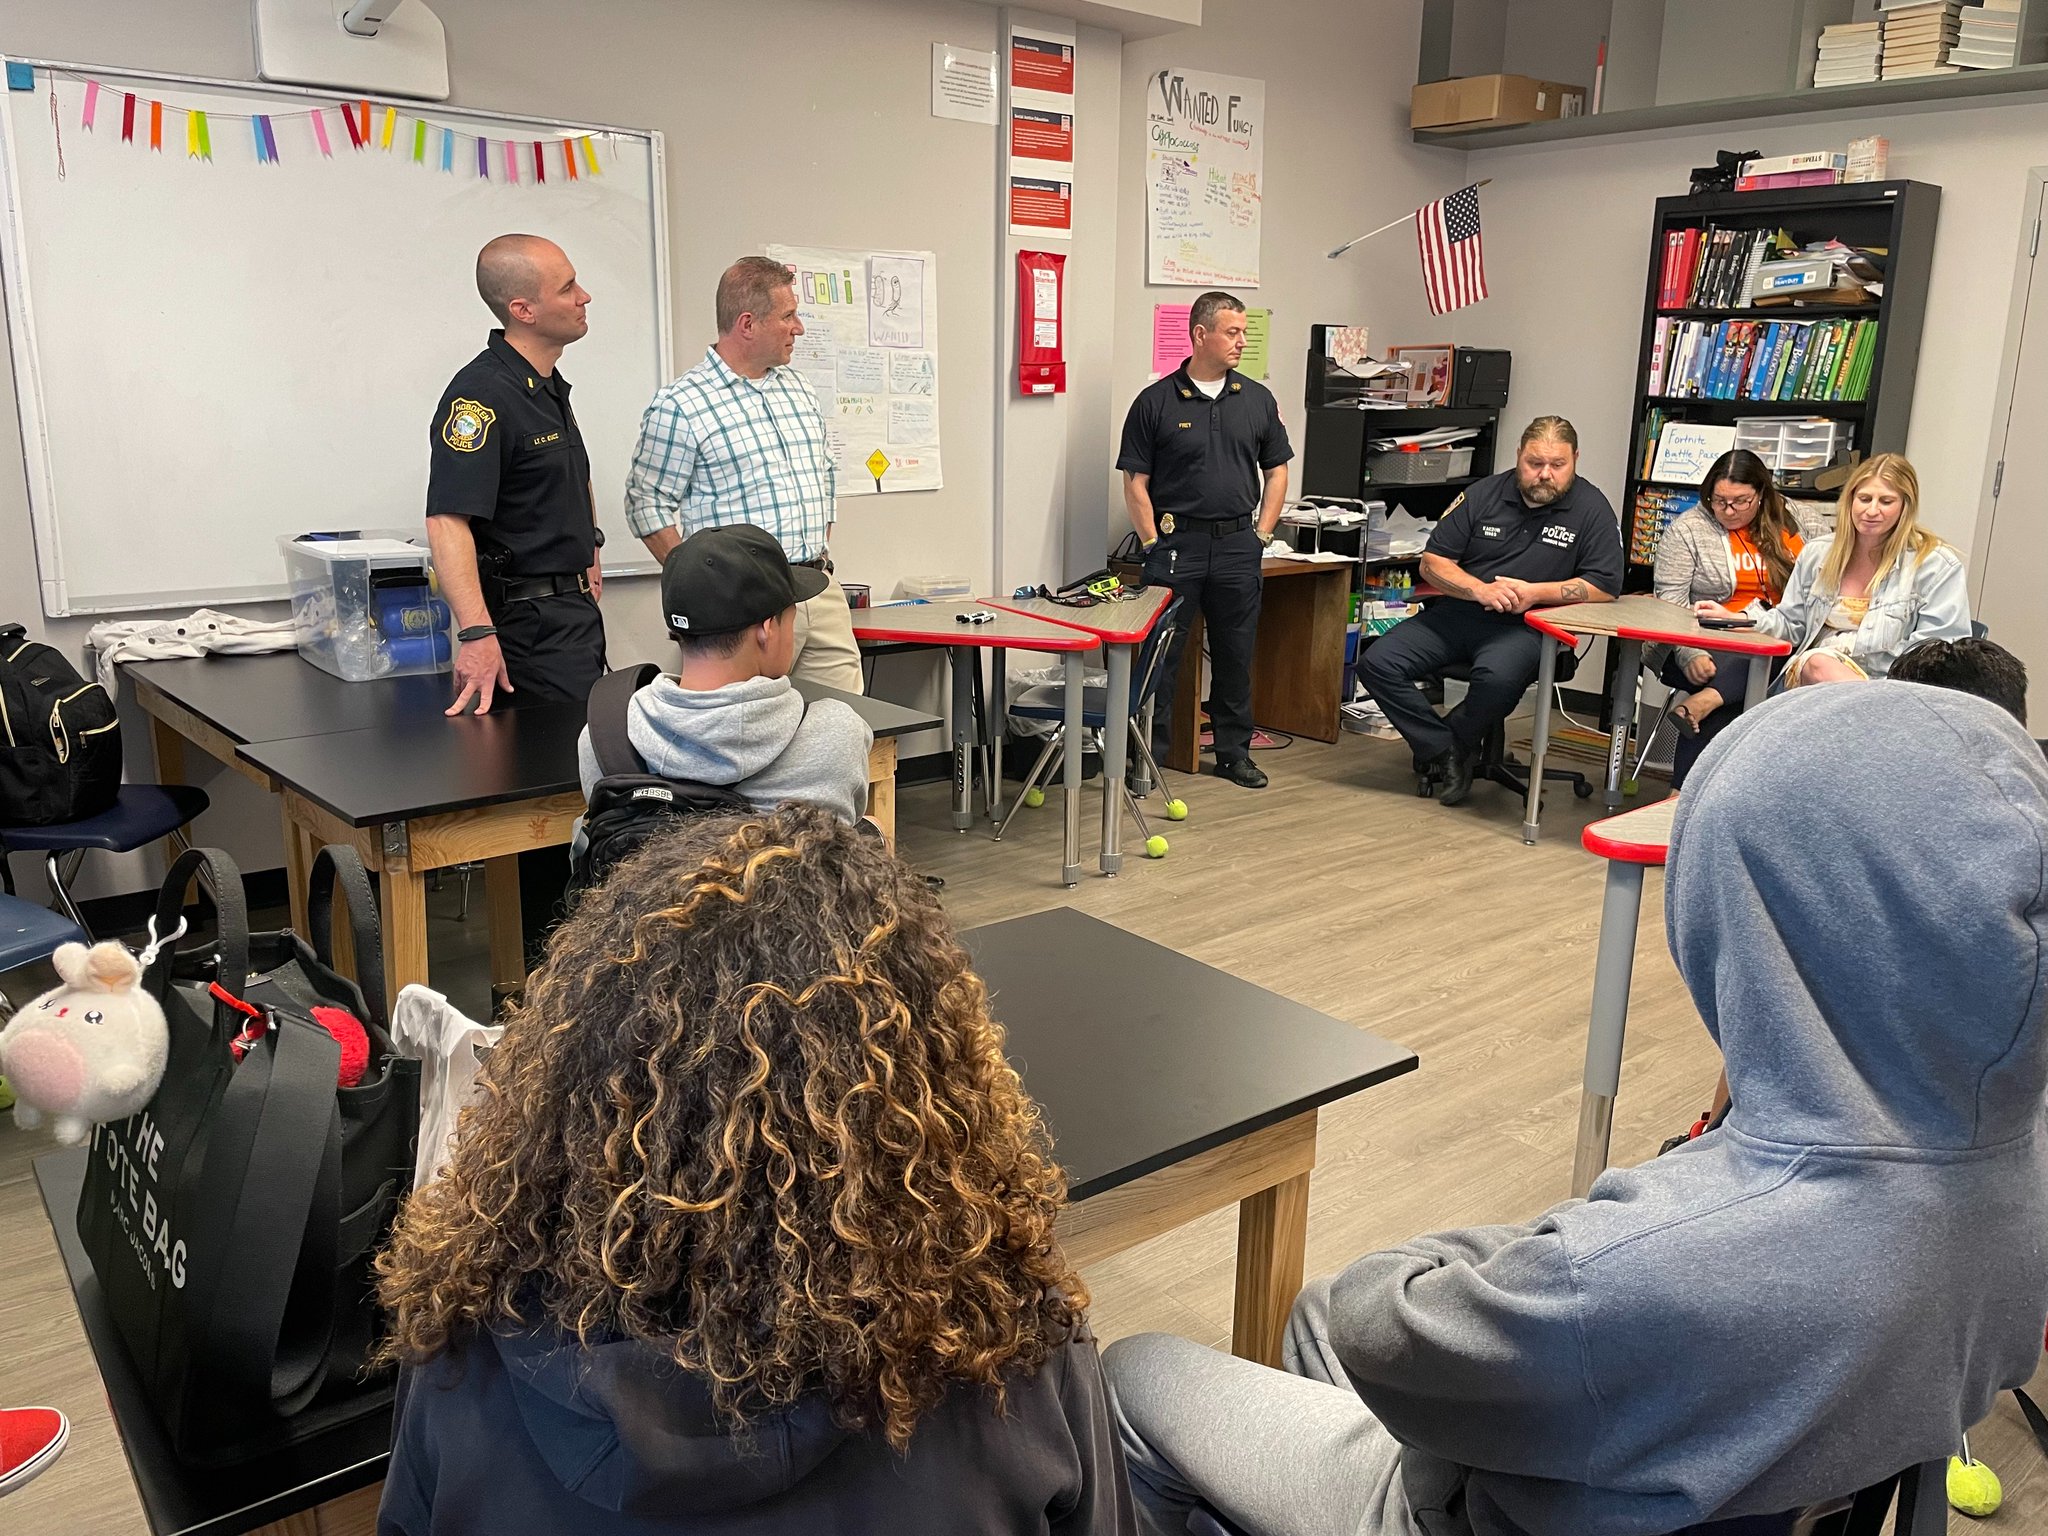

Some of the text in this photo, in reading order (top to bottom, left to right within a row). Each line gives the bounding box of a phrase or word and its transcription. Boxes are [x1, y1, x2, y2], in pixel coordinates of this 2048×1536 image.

[455, 403, 491, 422] HOBOKEN
[449, 435, 473, 449] POLICE
[1668, 428, 1707, 445] Fortnite
[1664, 448, 1720, 459] Battle Pass
[1656, 498, 1680, 511] Biology
[1541, 526, 1576, 543] POLICE
[143, 1189, 188, 1290] BAG
